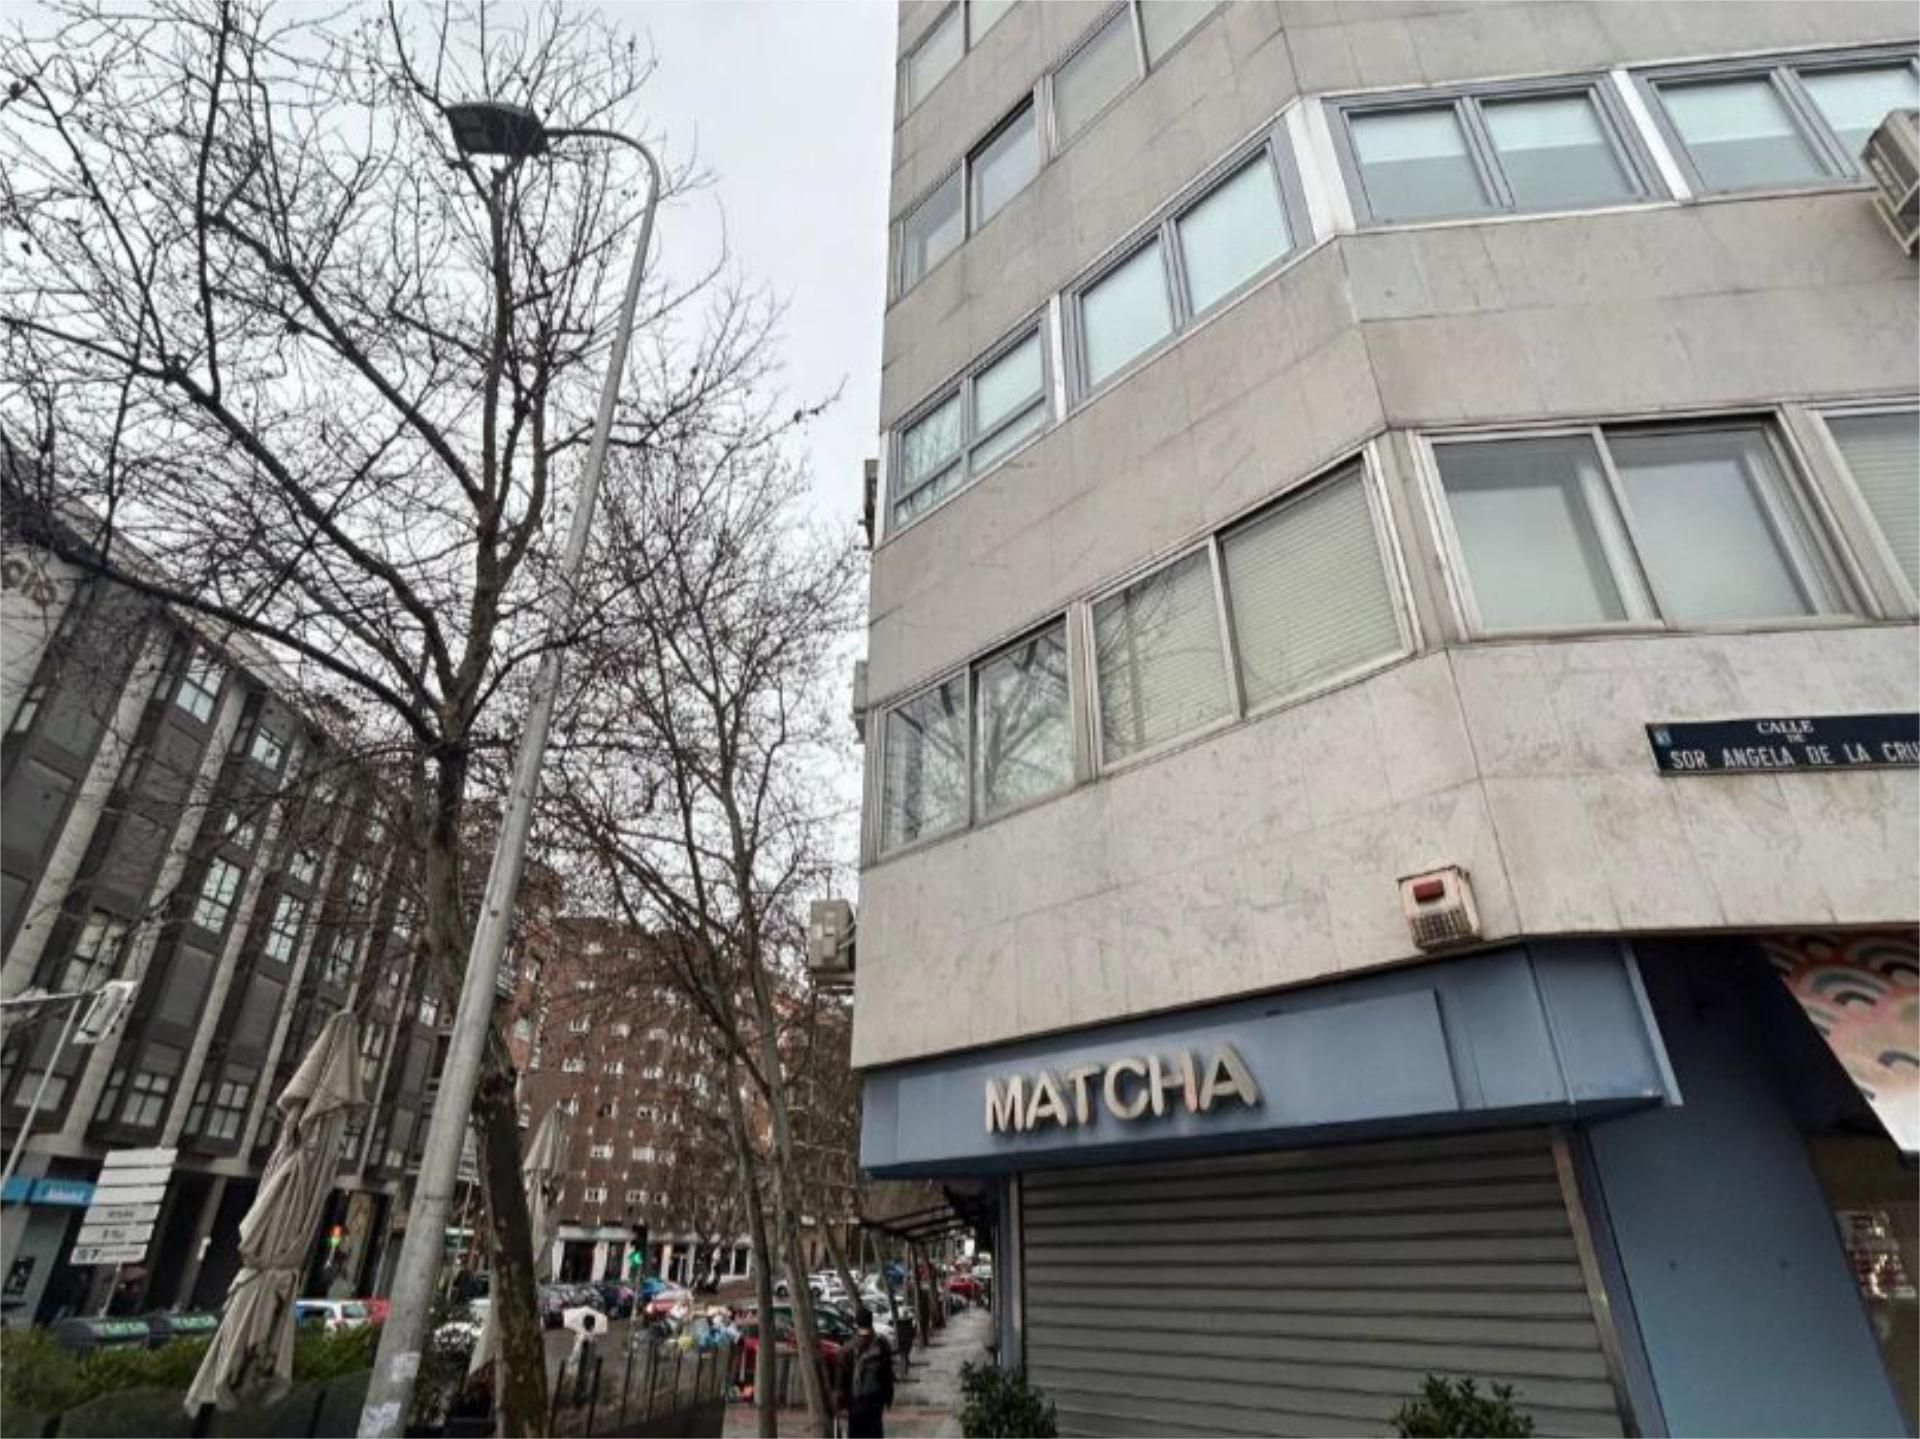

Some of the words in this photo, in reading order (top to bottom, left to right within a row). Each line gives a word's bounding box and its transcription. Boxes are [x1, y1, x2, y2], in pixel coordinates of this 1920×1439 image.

[1757, 720, 1814, 734] CALLE
[1670, 750, 1708, 769] SOR
[1722, 746, 1795, 768] ANGELA
[1805, 744, 1835, 764] DE
[1843, 742, 1872, 763] LA
[985, 1041, 1260, 1134] MATCHA
